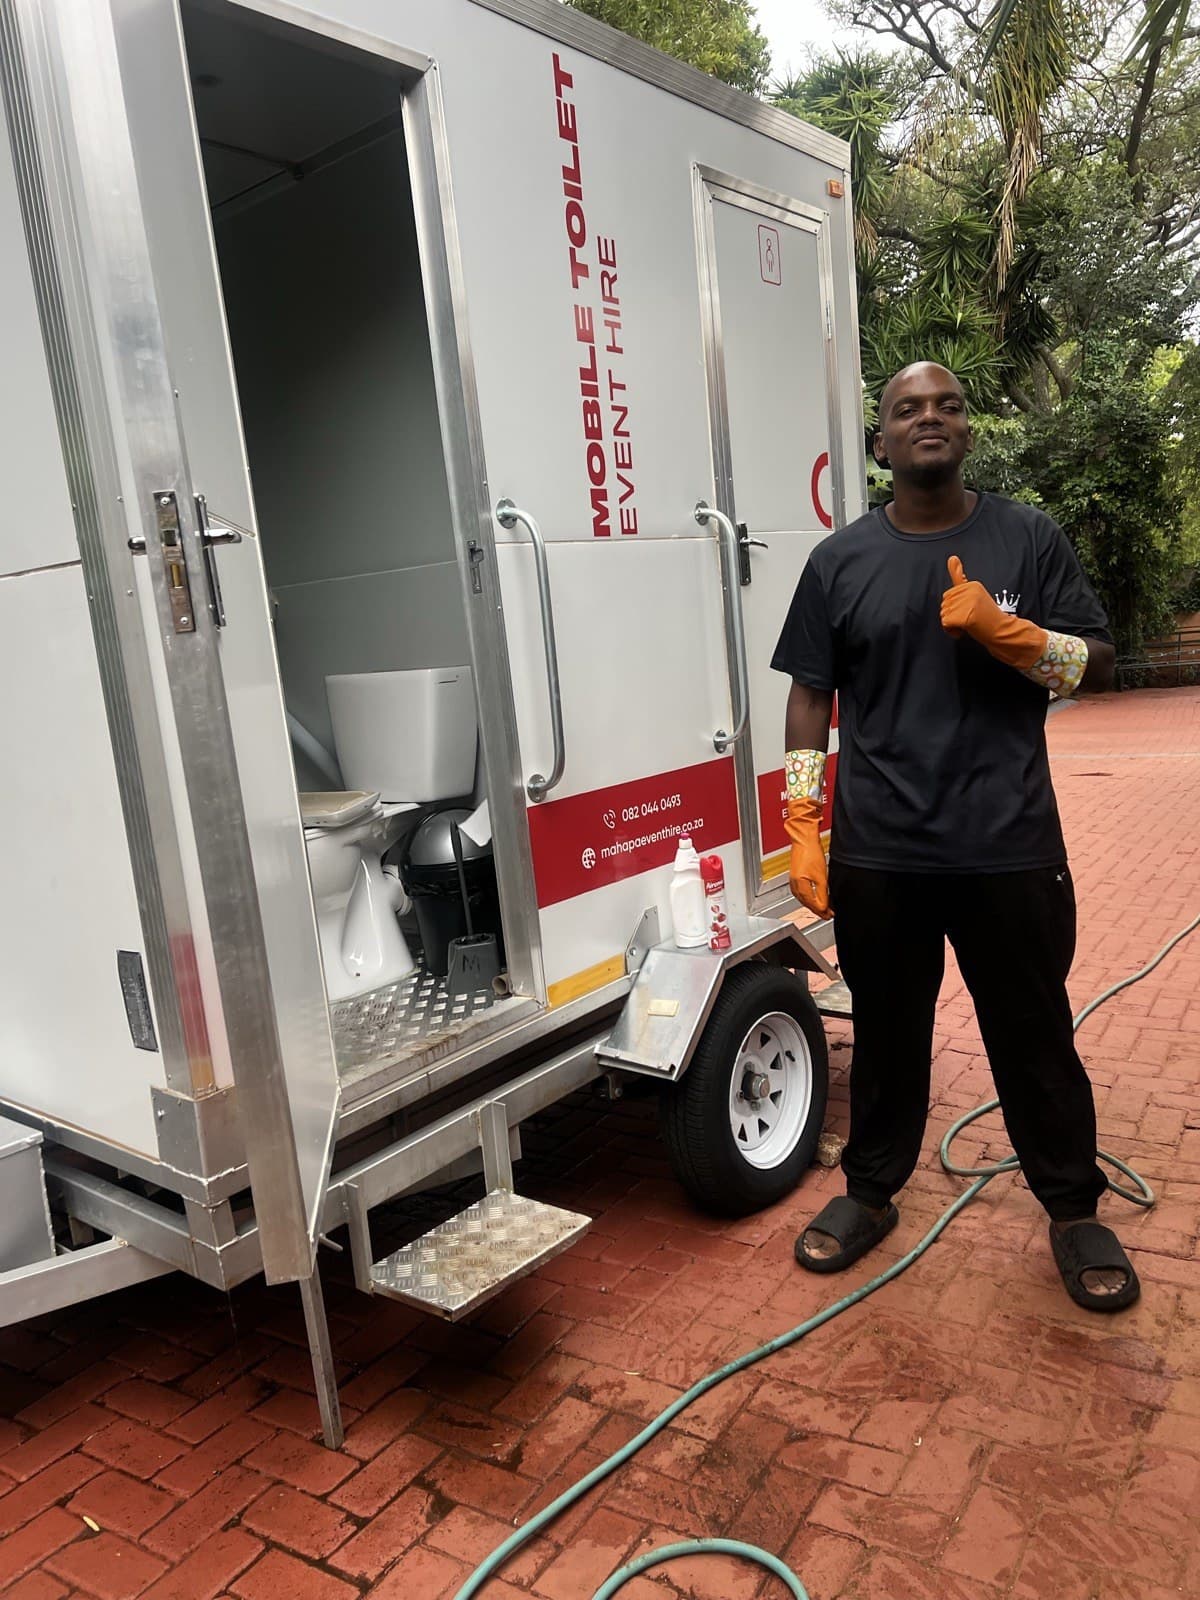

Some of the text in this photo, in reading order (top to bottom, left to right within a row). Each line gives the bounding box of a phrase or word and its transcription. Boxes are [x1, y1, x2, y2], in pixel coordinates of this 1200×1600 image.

[552, 52, 611, 537] MOBILE TOILET
[597, 235, 638, 535] EVENT HIRE
[601, 818, 704, 859] mahapaeventhire.co.za
[621, 794, 681, 822] 082 044 0493
